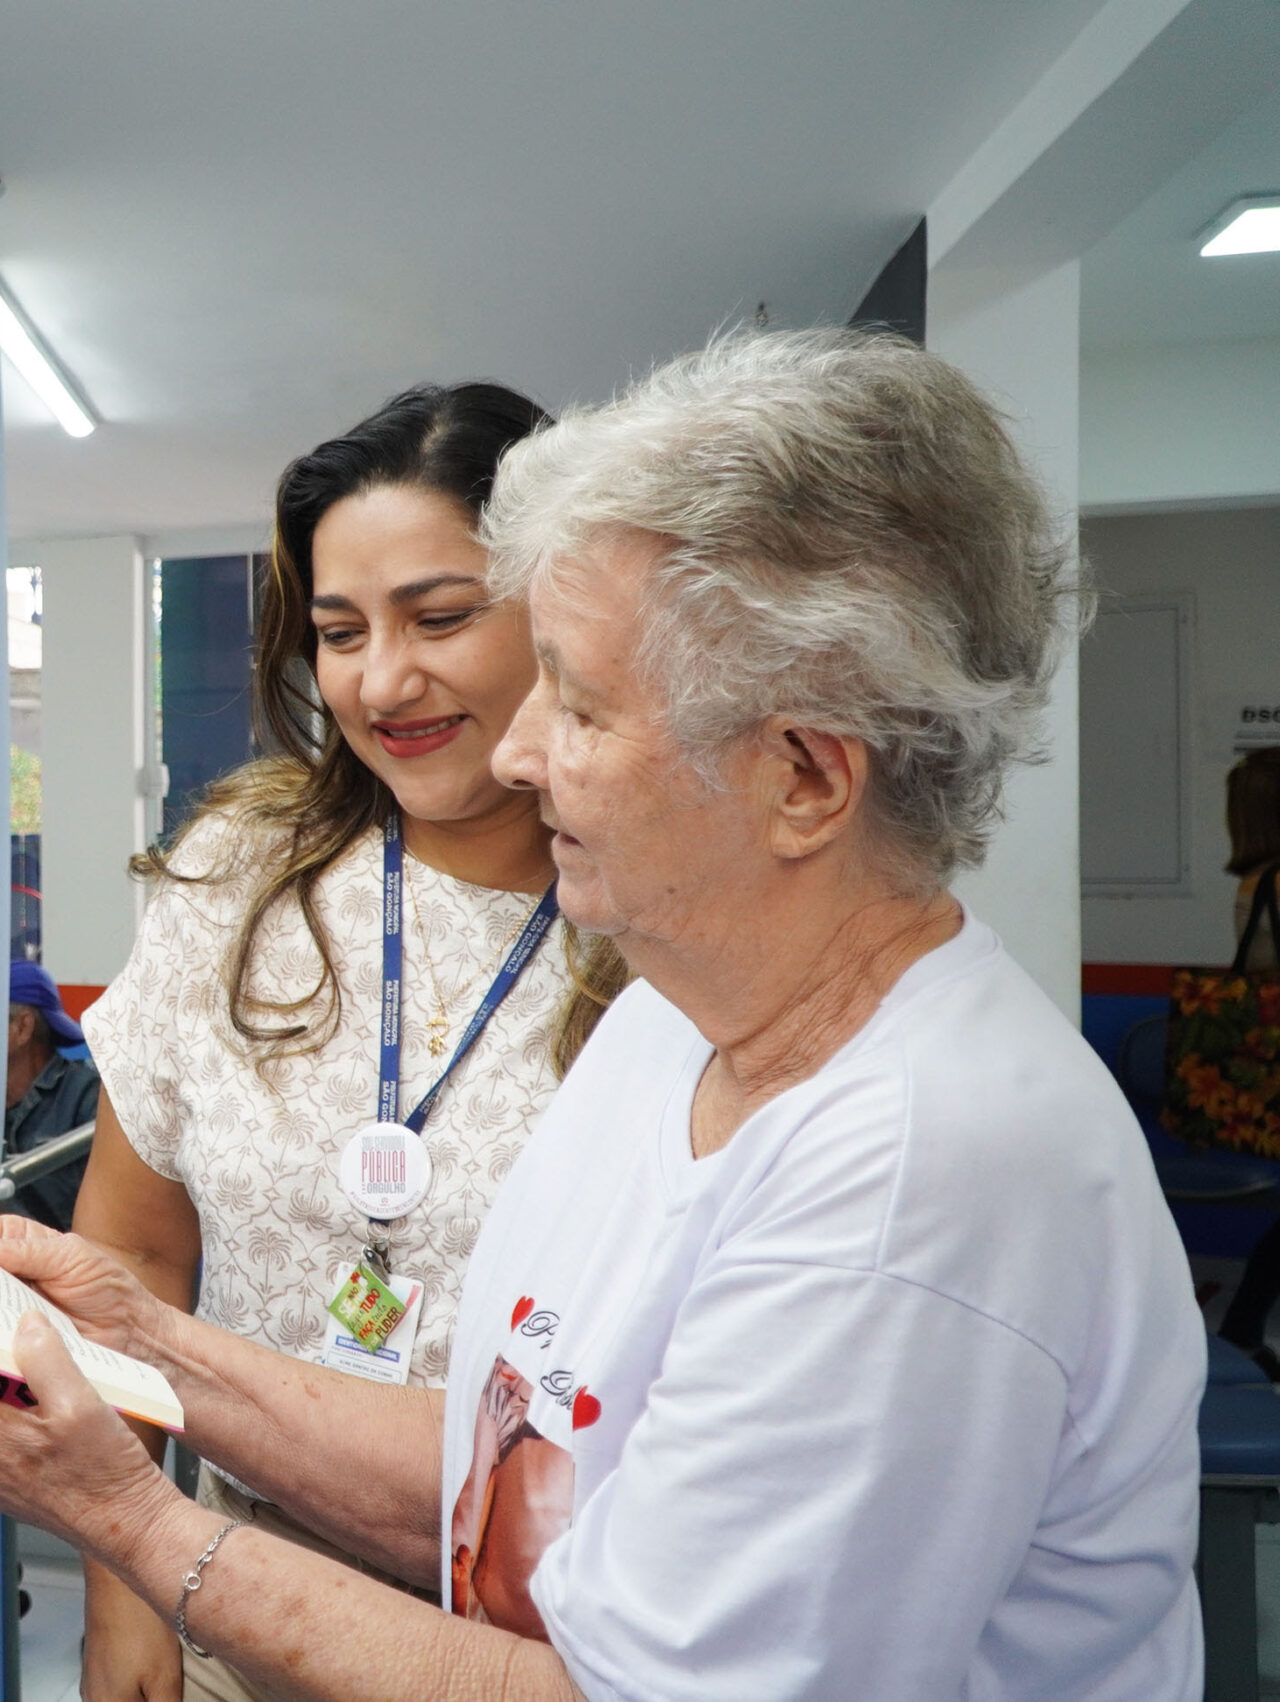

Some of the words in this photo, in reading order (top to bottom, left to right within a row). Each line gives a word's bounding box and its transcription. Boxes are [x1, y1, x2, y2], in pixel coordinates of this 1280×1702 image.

[386, 871, 394, 887] SÃO
[385, 887, 393, 935] GONÇALO
[505, 932, 532, 973] GONÇALO
[385, 980, 393, 996] SÃO
[384, 996, 392, 1047] GONÇALO
[382, 1081, 391, 1102] SÃO
[361, 1147, 406, 1183] PÚBLICA
[367, 1182, 406, 1194] ORGULHO
[360, 1287, 382, 1315] TUDO
[375, 1306, 402, 1339] PUDER
